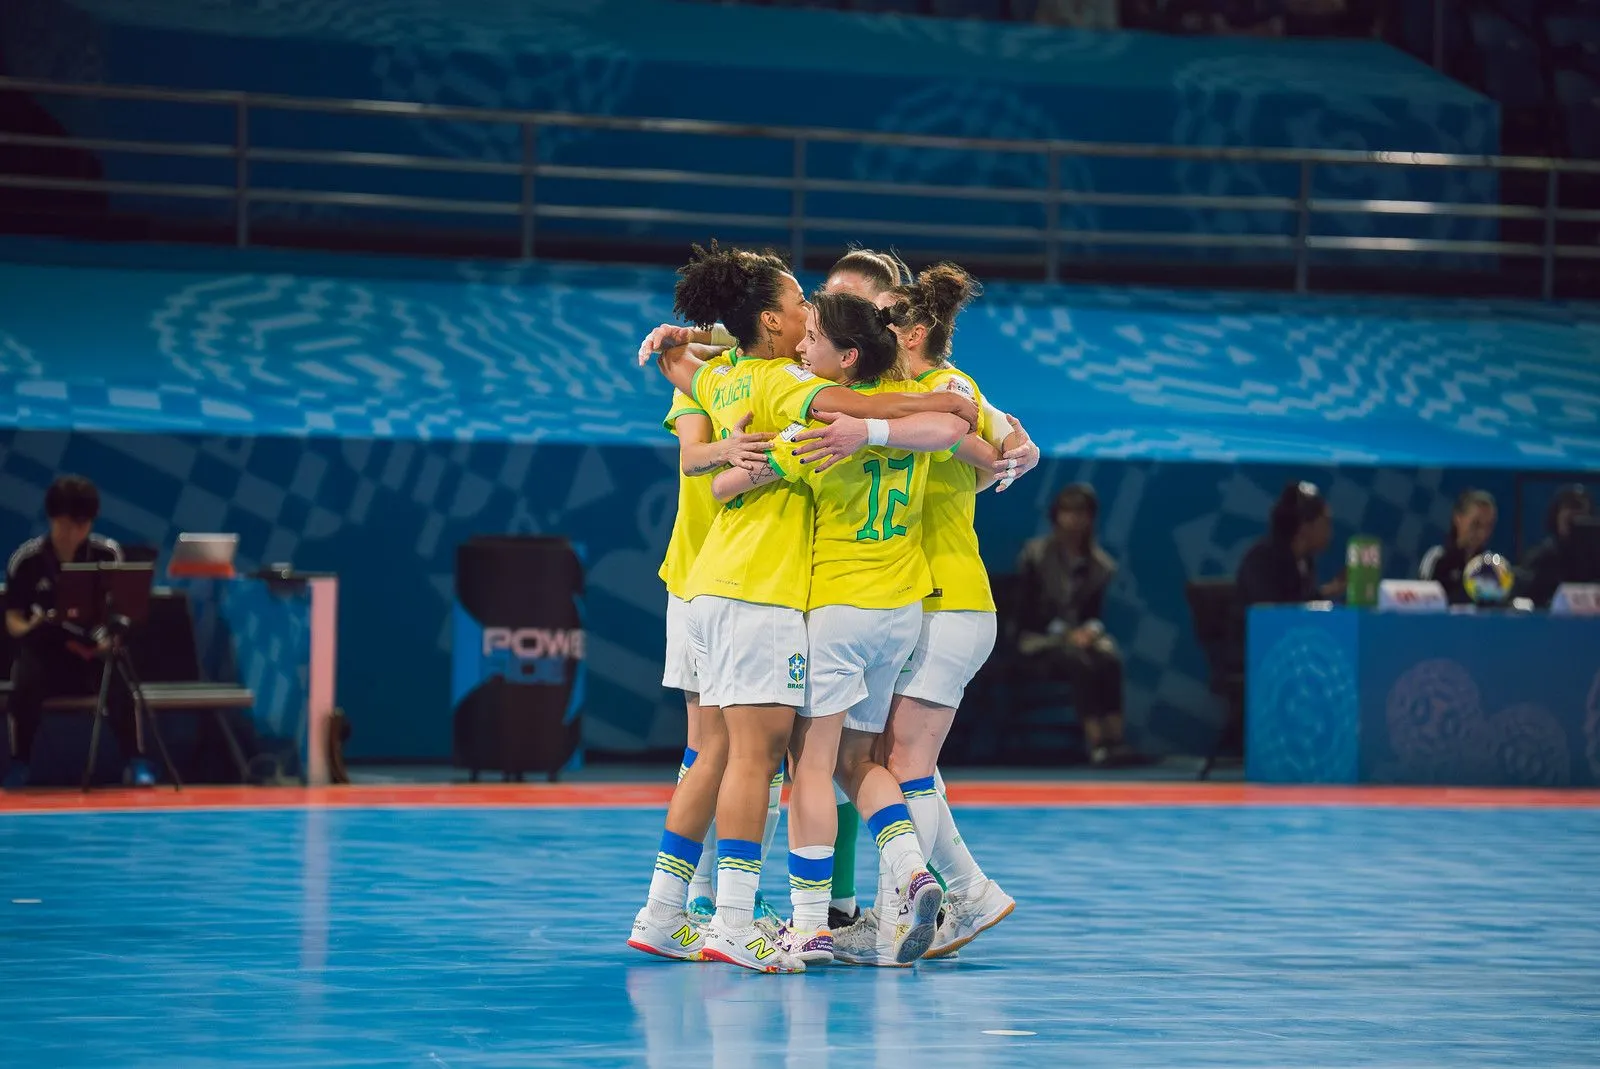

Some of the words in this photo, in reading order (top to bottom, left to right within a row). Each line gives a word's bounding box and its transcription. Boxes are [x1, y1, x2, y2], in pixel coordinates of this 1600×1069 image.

[856, 453, 914, 541] 12
[671, 924, 700, 947] N
[745, 937, 776, 960] N
